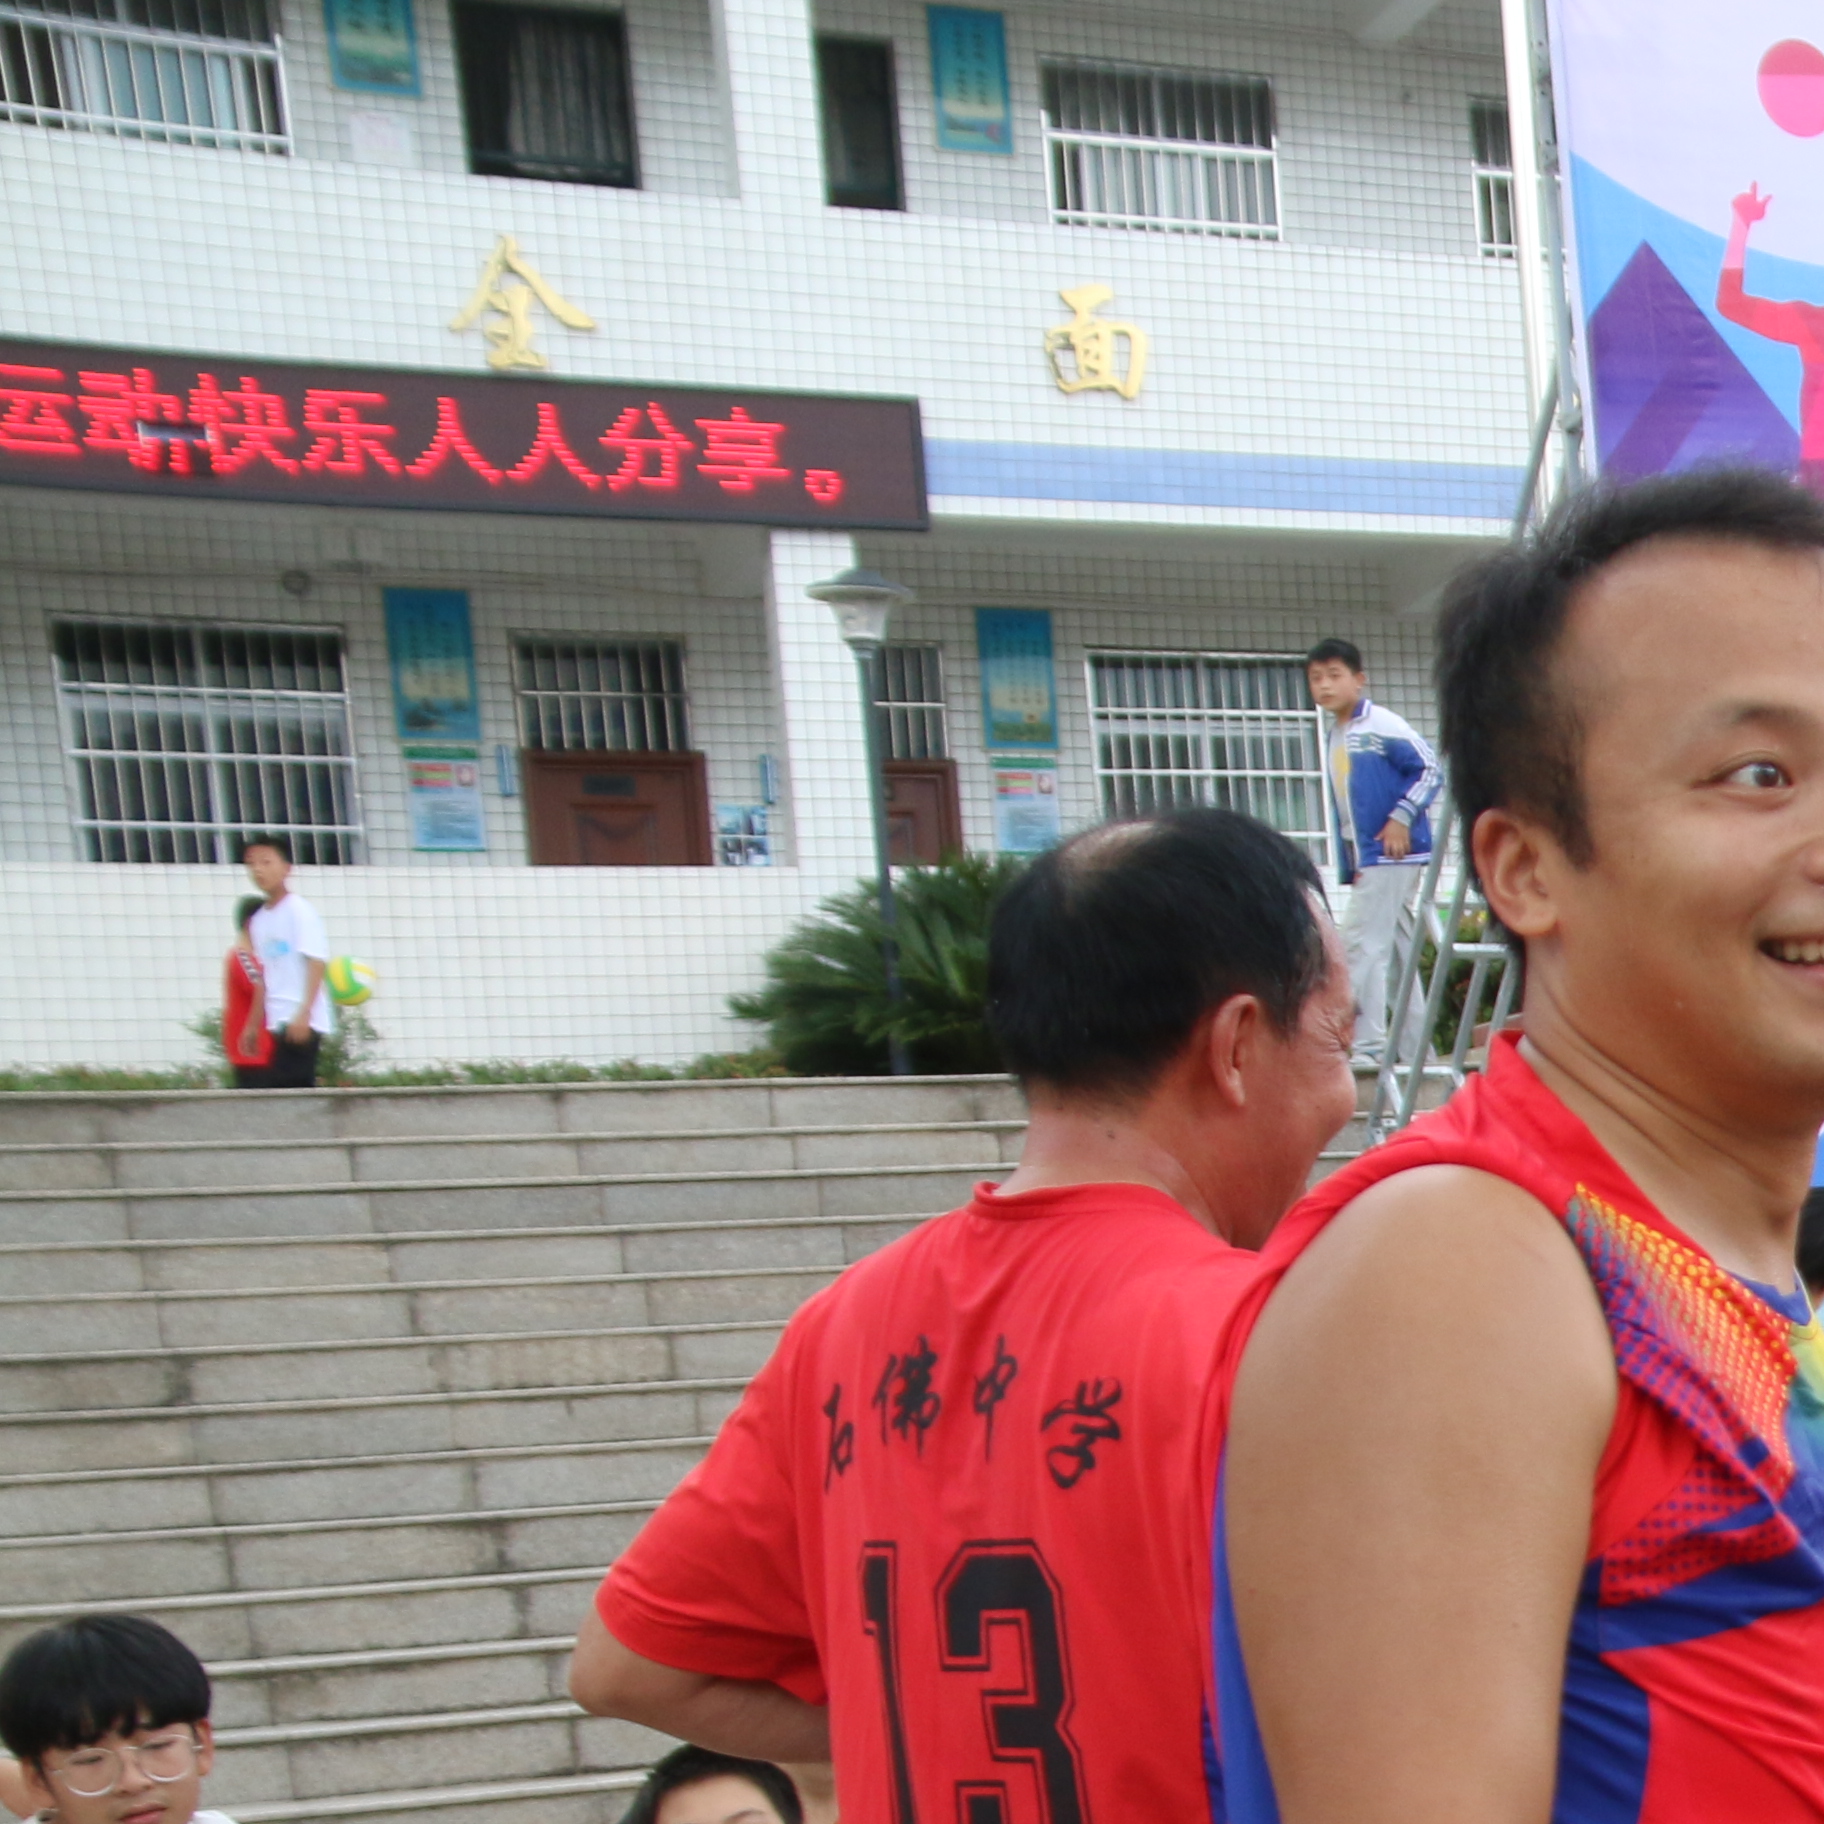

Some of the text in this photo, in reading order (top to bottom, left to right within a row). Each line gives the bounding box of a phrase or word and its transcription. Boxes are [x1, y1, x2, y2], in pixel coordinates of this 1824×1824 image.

[449, 234, 1148, 400] 全 面
[822, 1334, 1123, 1490] 石佛中学
